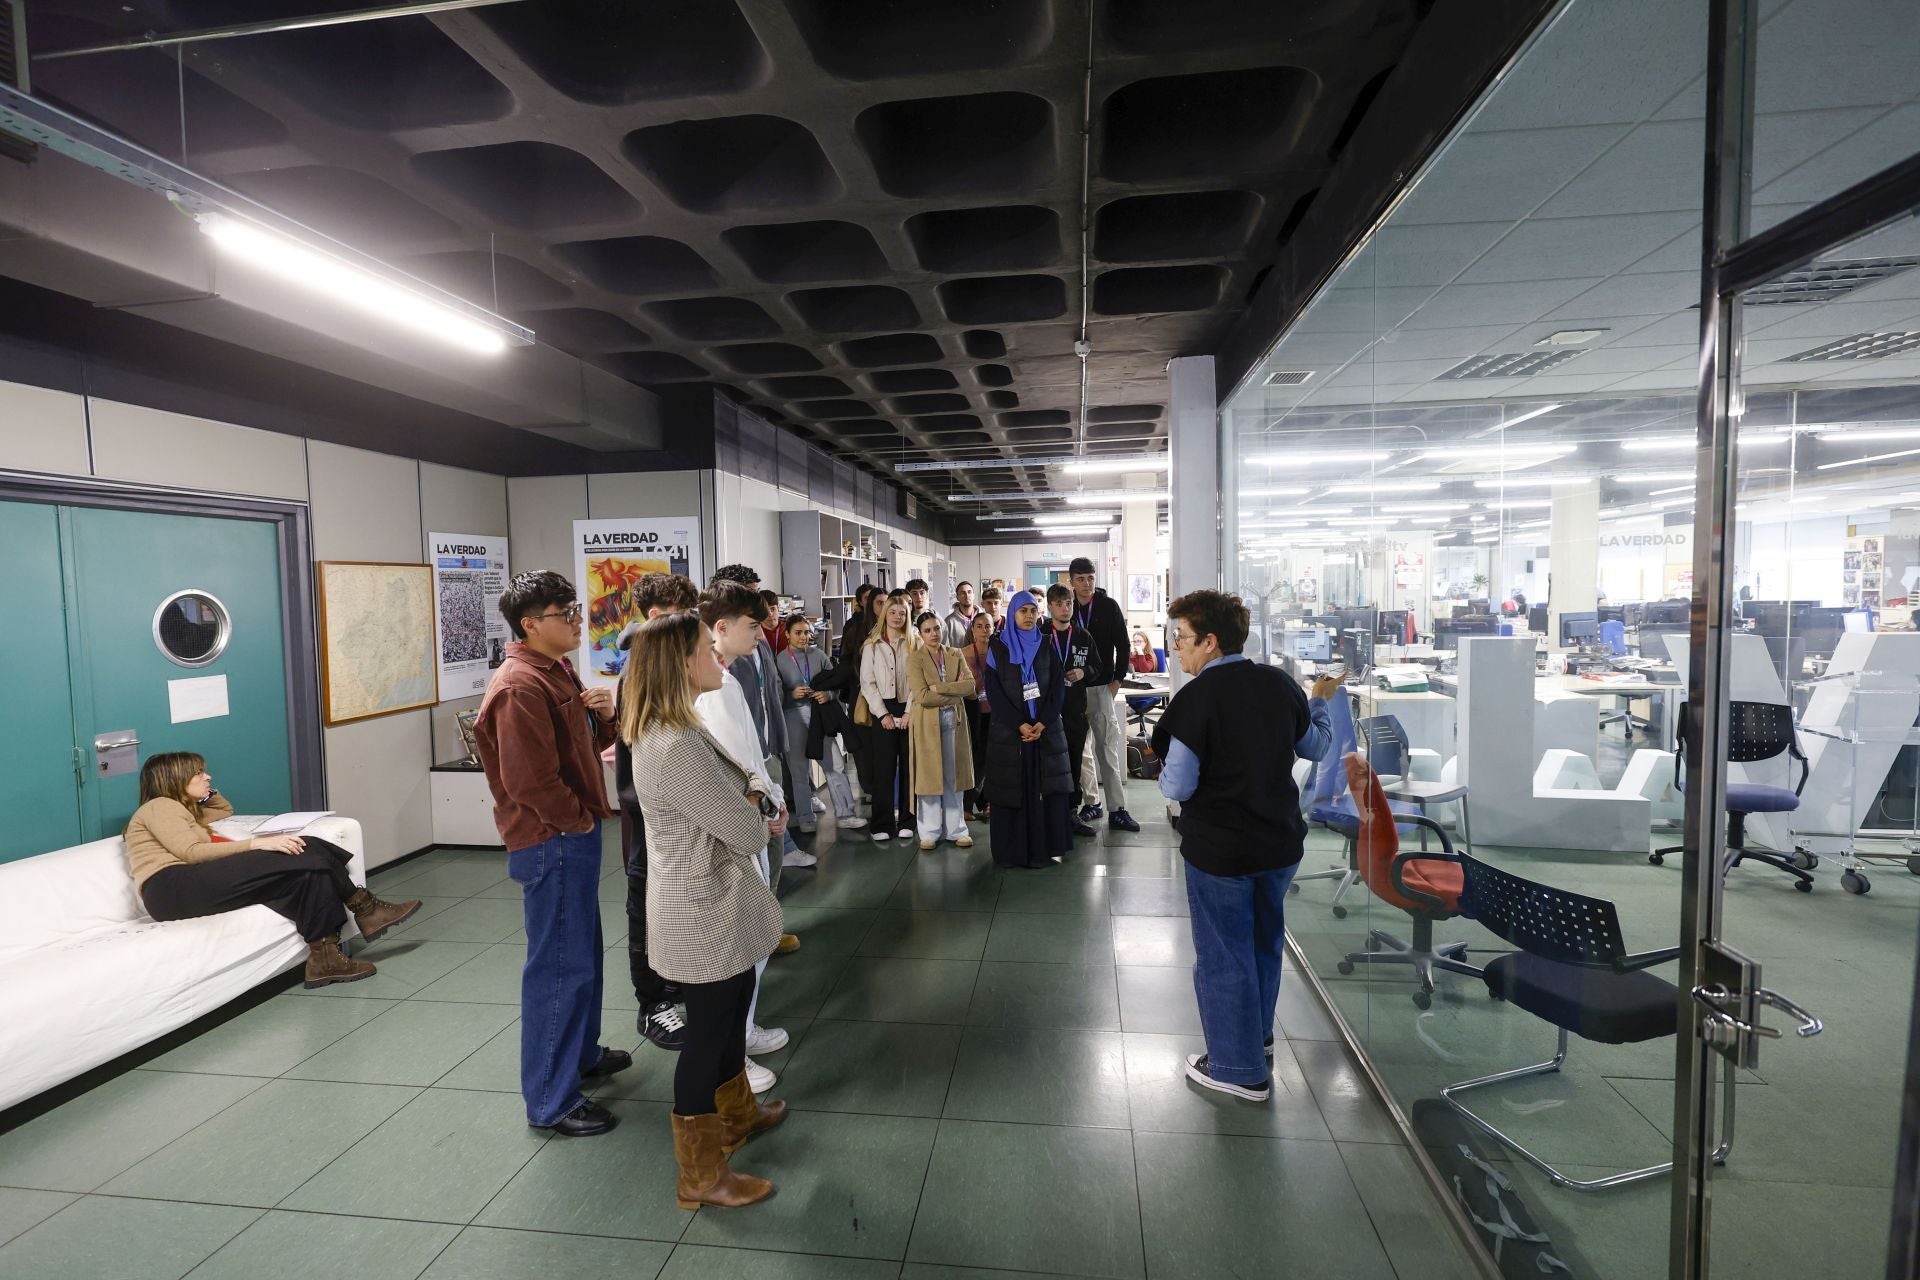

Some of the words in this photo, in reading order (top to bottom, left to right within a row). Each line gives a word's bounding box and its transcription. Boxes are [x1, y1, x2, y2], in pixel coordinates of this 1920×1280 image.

[583, 534, 601, 545] LA
[602, 532, 659, 545] VERDAD
[1599, 535, 1620, 547] LA
[1621, 534, 1686, 547] VERDAD
[437, 544, 450, 554] LA
[450, 544, 487, 556] VERDAD
